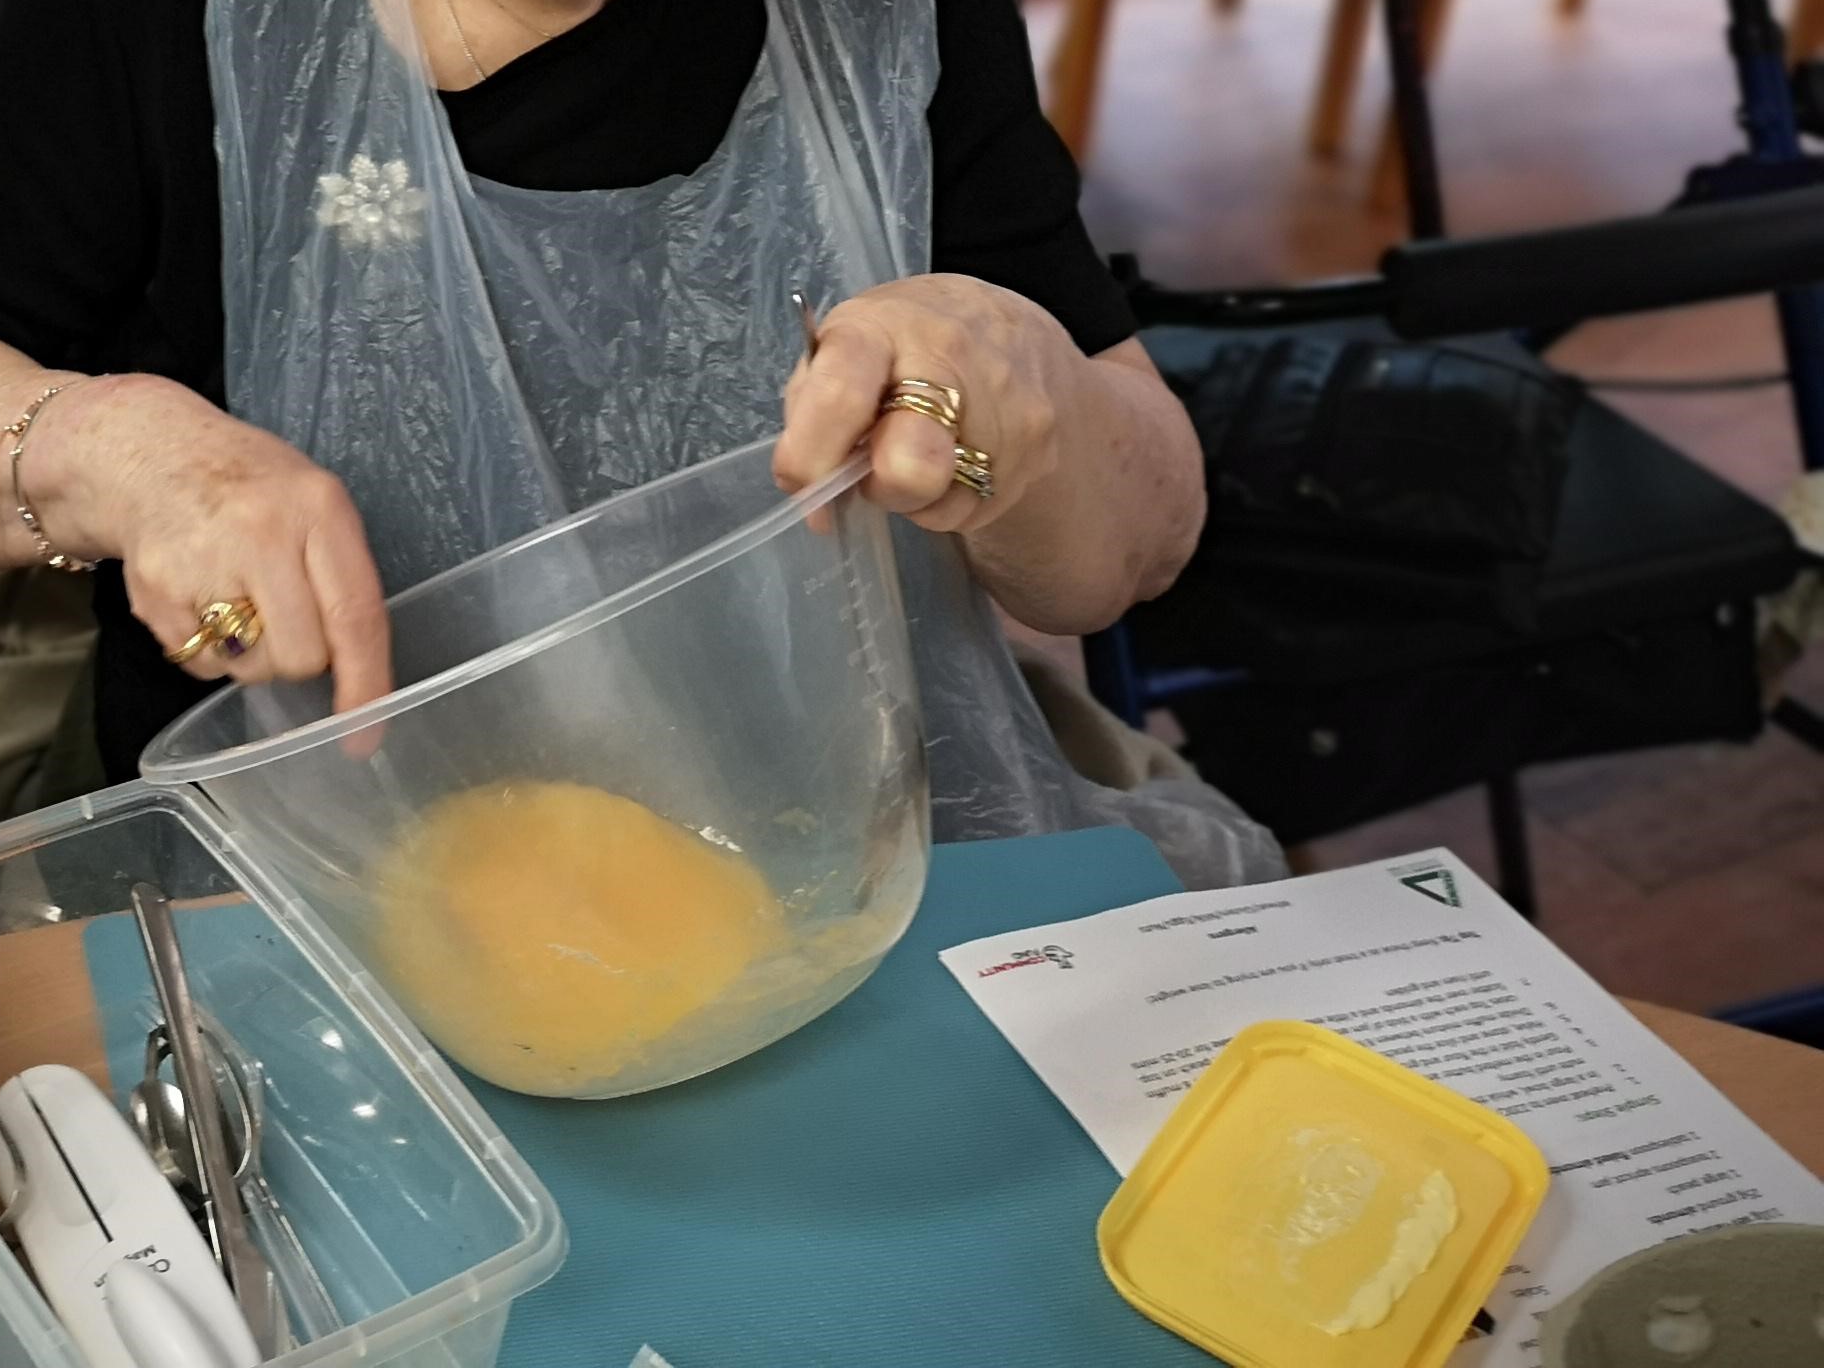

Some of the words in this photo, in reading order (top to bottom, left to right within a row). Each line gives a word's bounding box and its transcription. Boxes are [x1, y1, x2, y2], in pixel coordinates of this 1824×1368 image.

[1207, 926, 1257, 939] Allergens
[978, 956, 1046, 977] COMMUNITY
[1646, 1206, 1698, 1224] almonds
